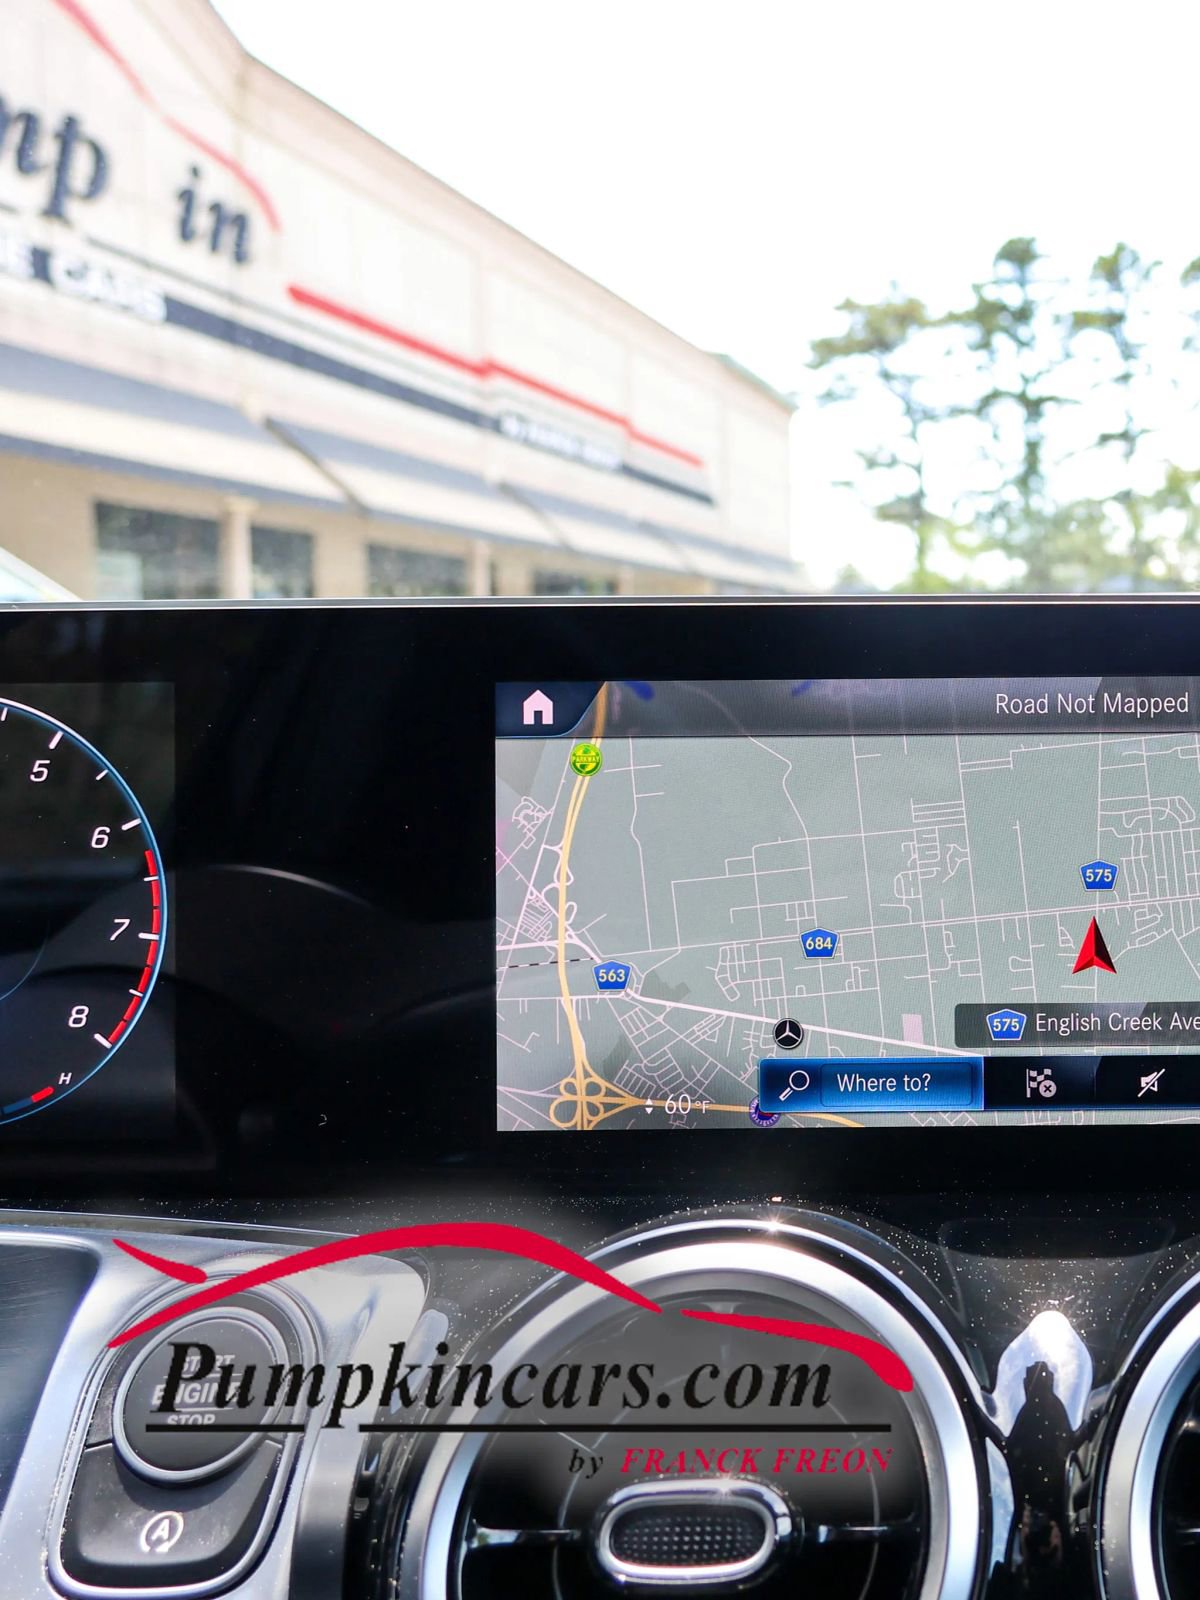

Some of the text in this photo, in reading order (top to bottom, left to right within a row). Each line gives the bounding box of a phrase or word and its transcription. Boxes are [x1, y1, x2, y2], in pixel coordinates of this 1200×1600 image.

[995, 691, 1189, 718] Road Not Mapped
[29, 759, 51, 783] 5
[90, 826, 111, 848] 6
[1086, 868, 1112, 882] 575
[108, 918, 130, 941] 7
[805, 936, 833, 950] 684
[598, 969, 626, 983] 563
[68, 1005, 90, 1028] 8
[992, 1018, 1020, 1032] 575
[1035, 1012, 1101, 1037] English
[1108, 1012, 1163, 1032] Creek
[58, 1072, 72, 1085] H
[837, 1073, 931, 1092] Where to?
